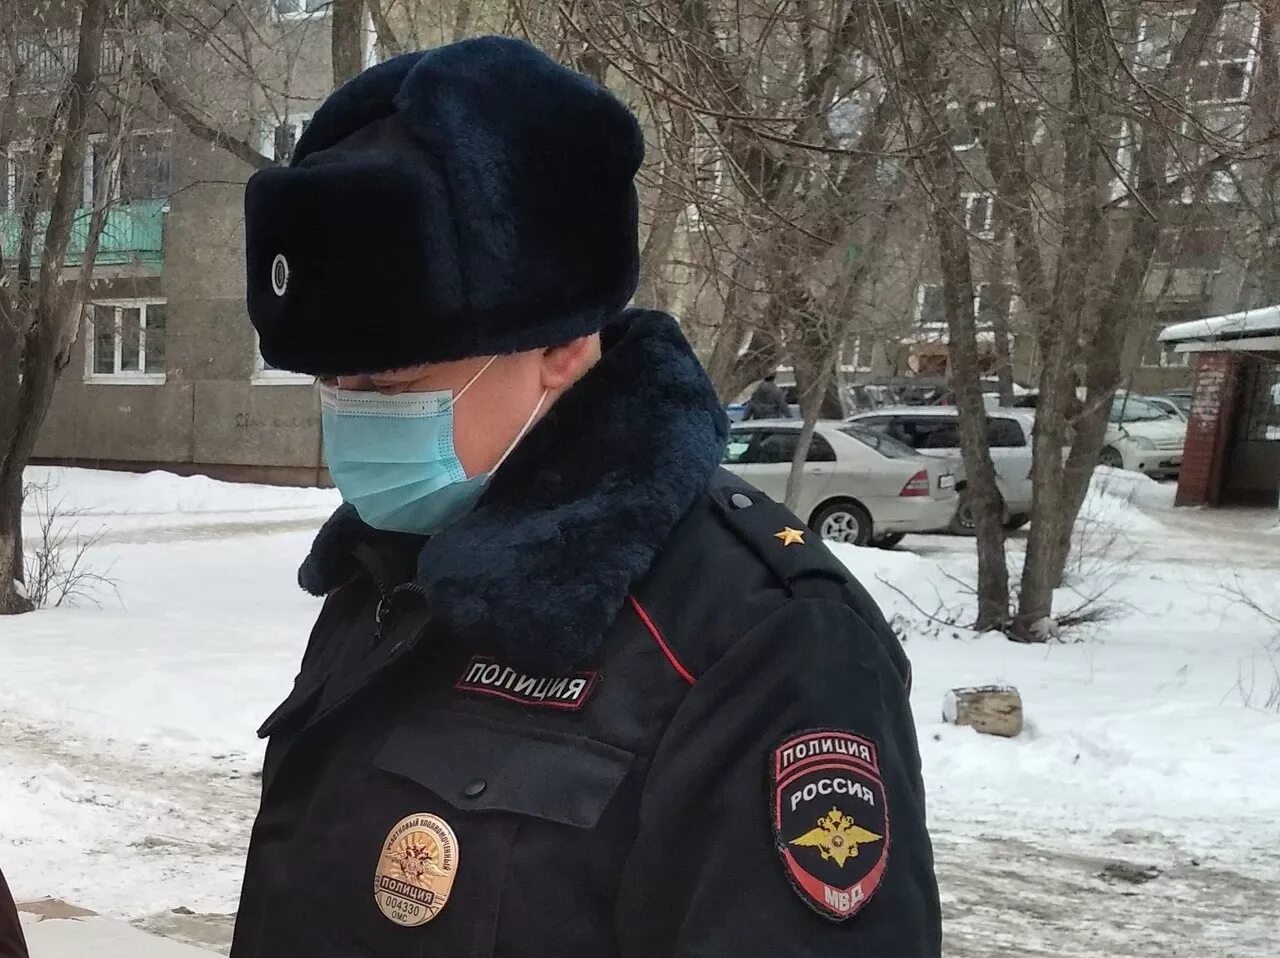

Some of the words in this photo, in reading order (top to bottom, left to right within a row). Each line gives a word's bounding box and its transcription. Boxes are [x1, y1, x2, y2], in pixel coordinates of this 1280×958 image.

[465, 663, 587, 701] ПОЛИЦИЯ
[782, 738, 872, 768] ПОЛИЦИЯ
[790, 777, 876, 812] РОССИЯ
[381, 877, 433, 904] ПОЛИЦИЯ
[823, 884, 865, 913] МВД
[385, 896, 420, 916] 004330
